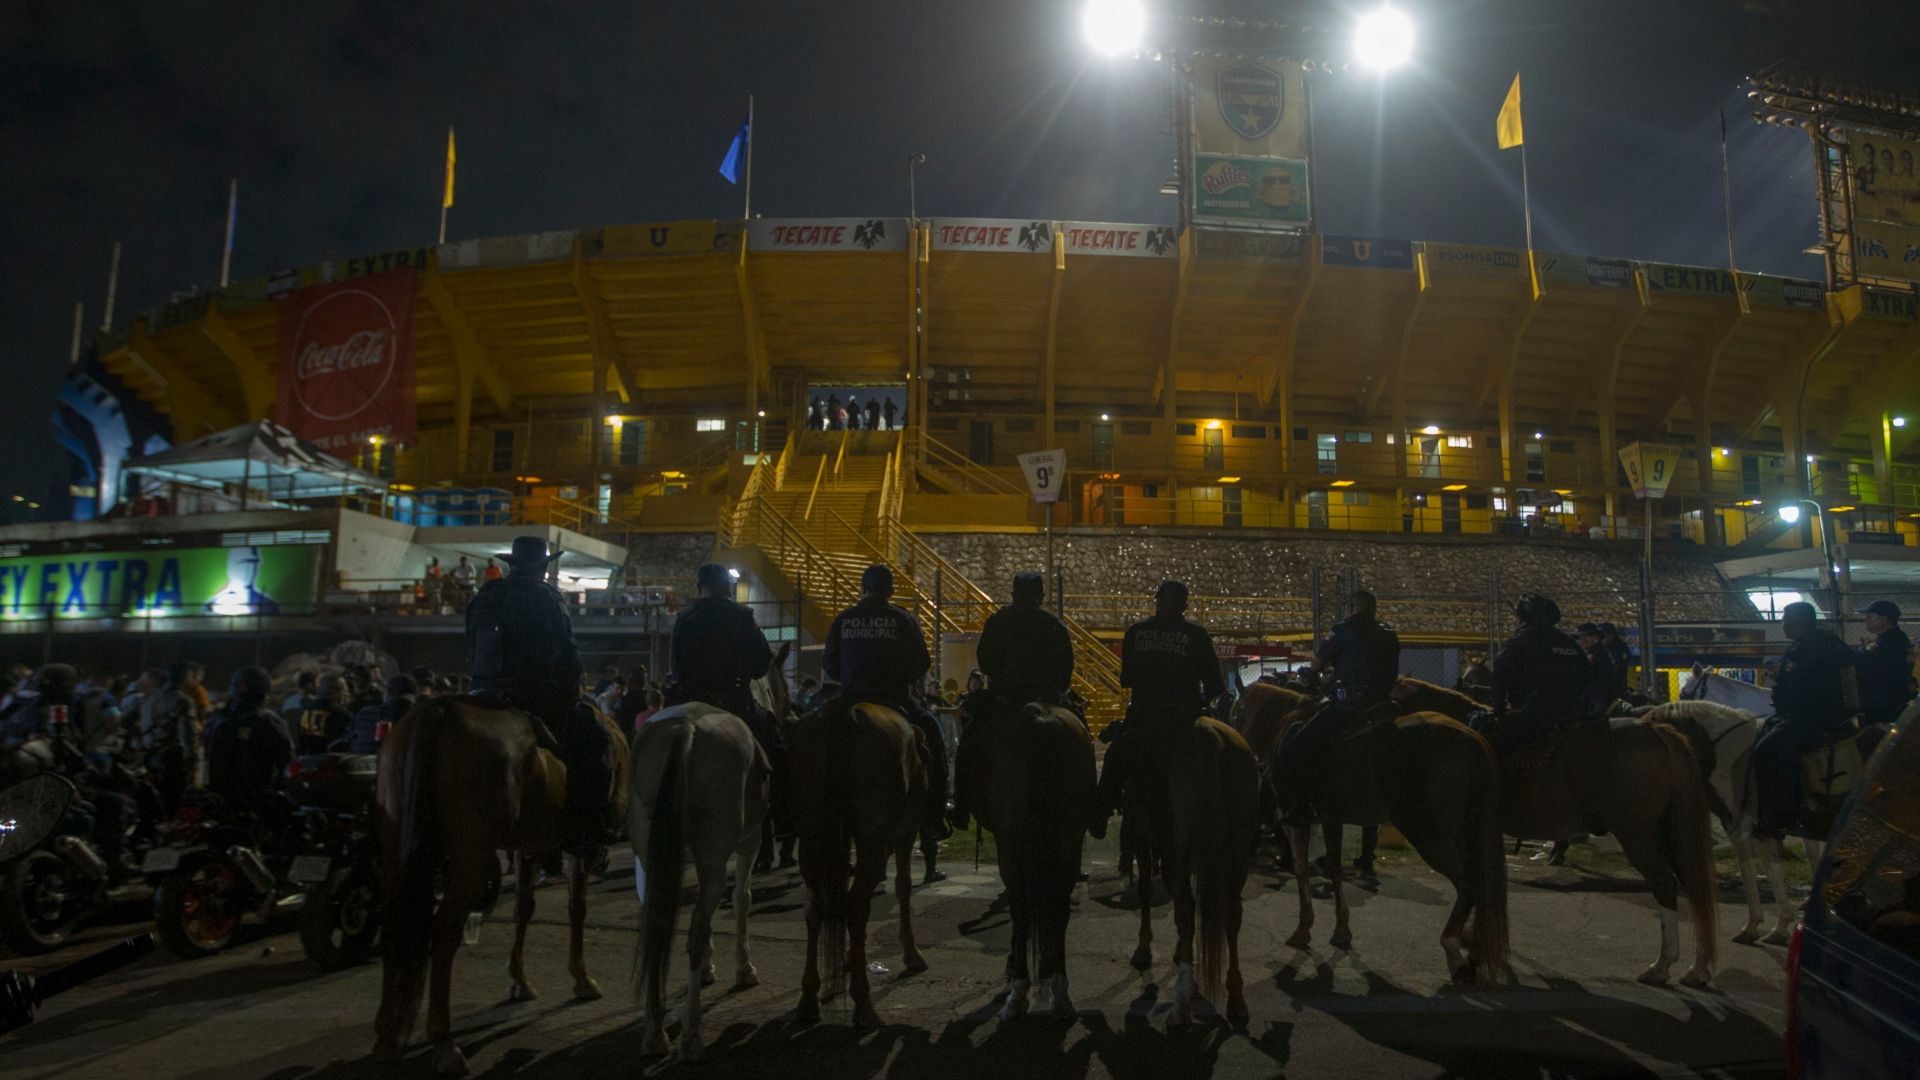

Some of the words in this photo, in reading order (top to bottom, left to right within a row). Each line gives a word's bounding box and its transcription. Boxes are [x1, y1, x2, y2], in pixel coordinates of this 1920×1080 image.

[1203, 163, 1249, 193] Ruffles
[649, 227, 669, 248] U
[773, 225, 846, 246] TECATE
[940, 225, 1013, 246] TECATE
[1068, 229, 1140, 250] TECATE
[1351, 240, 1371, 261] U
[348, 247, 427, 276] EXTRA
[1663, 268, 1735, 294] EXTRA
[1028, 454, 1054, 465] GENERAL
[1630, 461, 1639, 484] 9
[1653, 459, 1664, 482] 9
[40, 557, 183, 617] EXTRA
[841, 627, 897, 640] MUNICIPAL
[1135, 639, 1187, 657] MUNICIPAL
